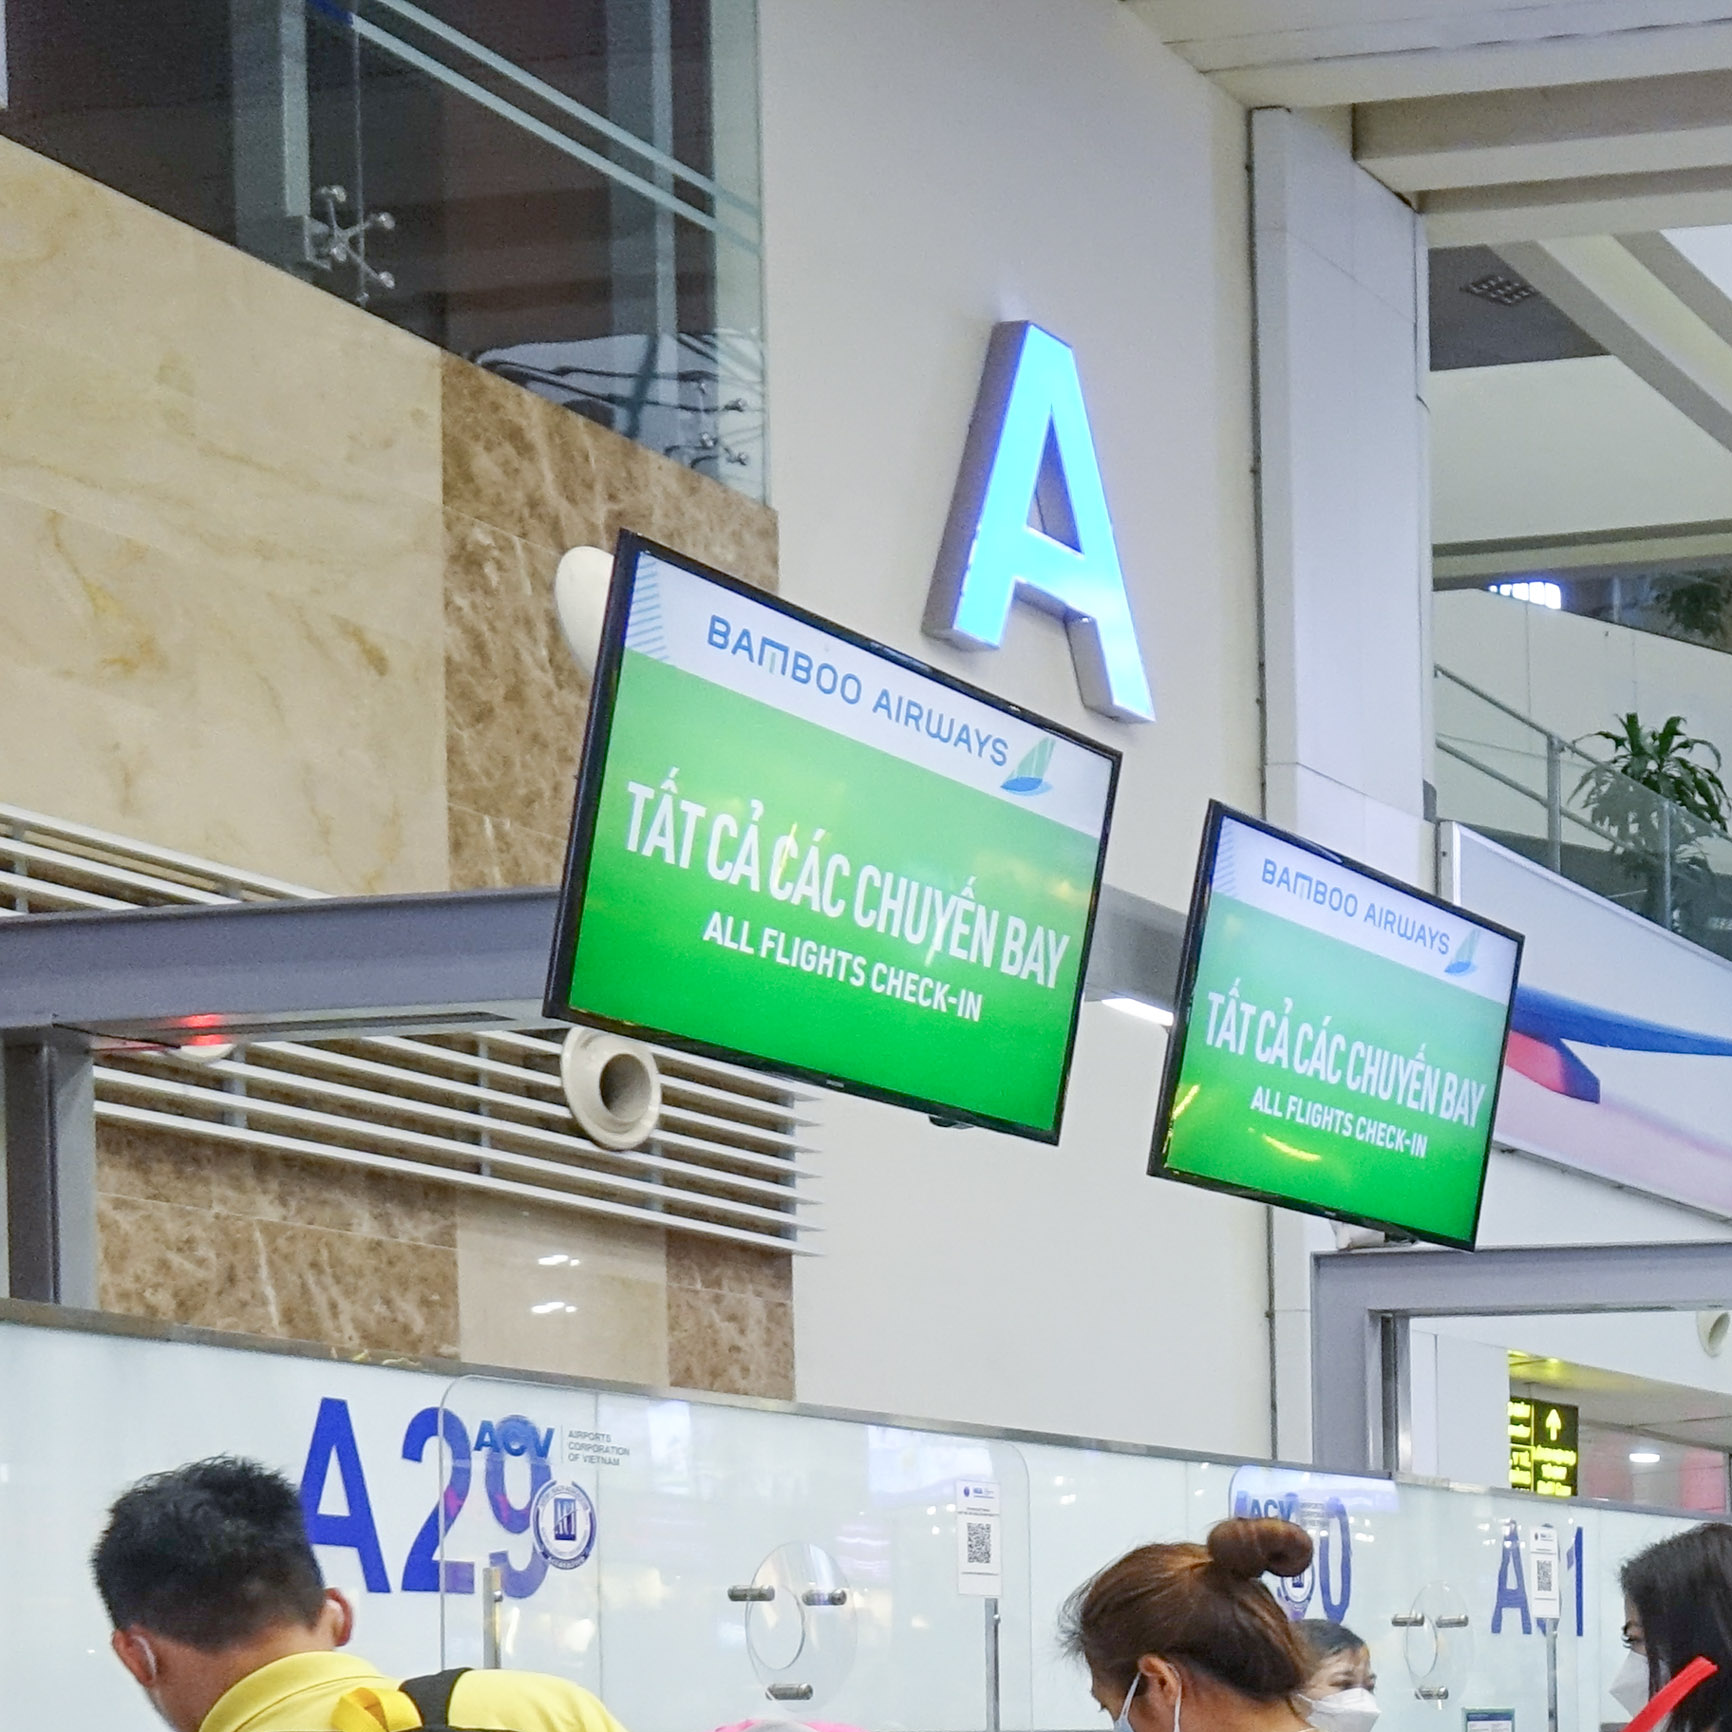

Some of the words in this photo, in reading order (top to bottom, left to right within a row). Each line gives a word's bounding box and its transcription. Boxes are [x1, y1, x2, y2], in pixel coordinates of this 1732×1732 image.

[938, 320, 1156, 724] A
[707, 614, 862, 705] BAMBOO
[872, 688, 1010, 767] AIRWAYS
[625, 766, 706, 868] TẤT
[707, 800, 764, 891] CẢ
[769, 828, 850, 918] CÁC
[853, 875, 999, 968] CHUYẾN
[1000, 916, 1070, 988] BAY
[1262, 858, 1358, 918] BAMBOO
[1364, 903, 1450, 955] AIRWAYS
[703, 911, 754, 955] ALL
[759, 928, 866, 987] FLIGHTS
[870, 962, 982, 1022] CHECK-IN
[1205, 977, 1257, 1055] TẤT
[1255, 997, 1293, 1069] CẢ
[1293, 1015, 1346, 1084] CÁC
[1347, 1043, 1441, 1115] CHUYẾN
[1438, 1070, 1487, 1128] BAY
[1250, 1086, 1283, 1119] ALL
[1285, 1094, 1353, 1137] FLIGHTS
[1355, 1116, 1428, 1158] CHECK-IN
[474, 1420, 555, 1458] ACV
[568, 1430, 611, 1443] AIRPORTS
[568, 1441, 630, 1456] CORPORATION
[568, 1453, 581, 1463] OF
[583, 1455, 620, 1466] VIETNAM
[300, 1396, 552, 1598] A29
[1491, 1520, 1583, 1636] A1
